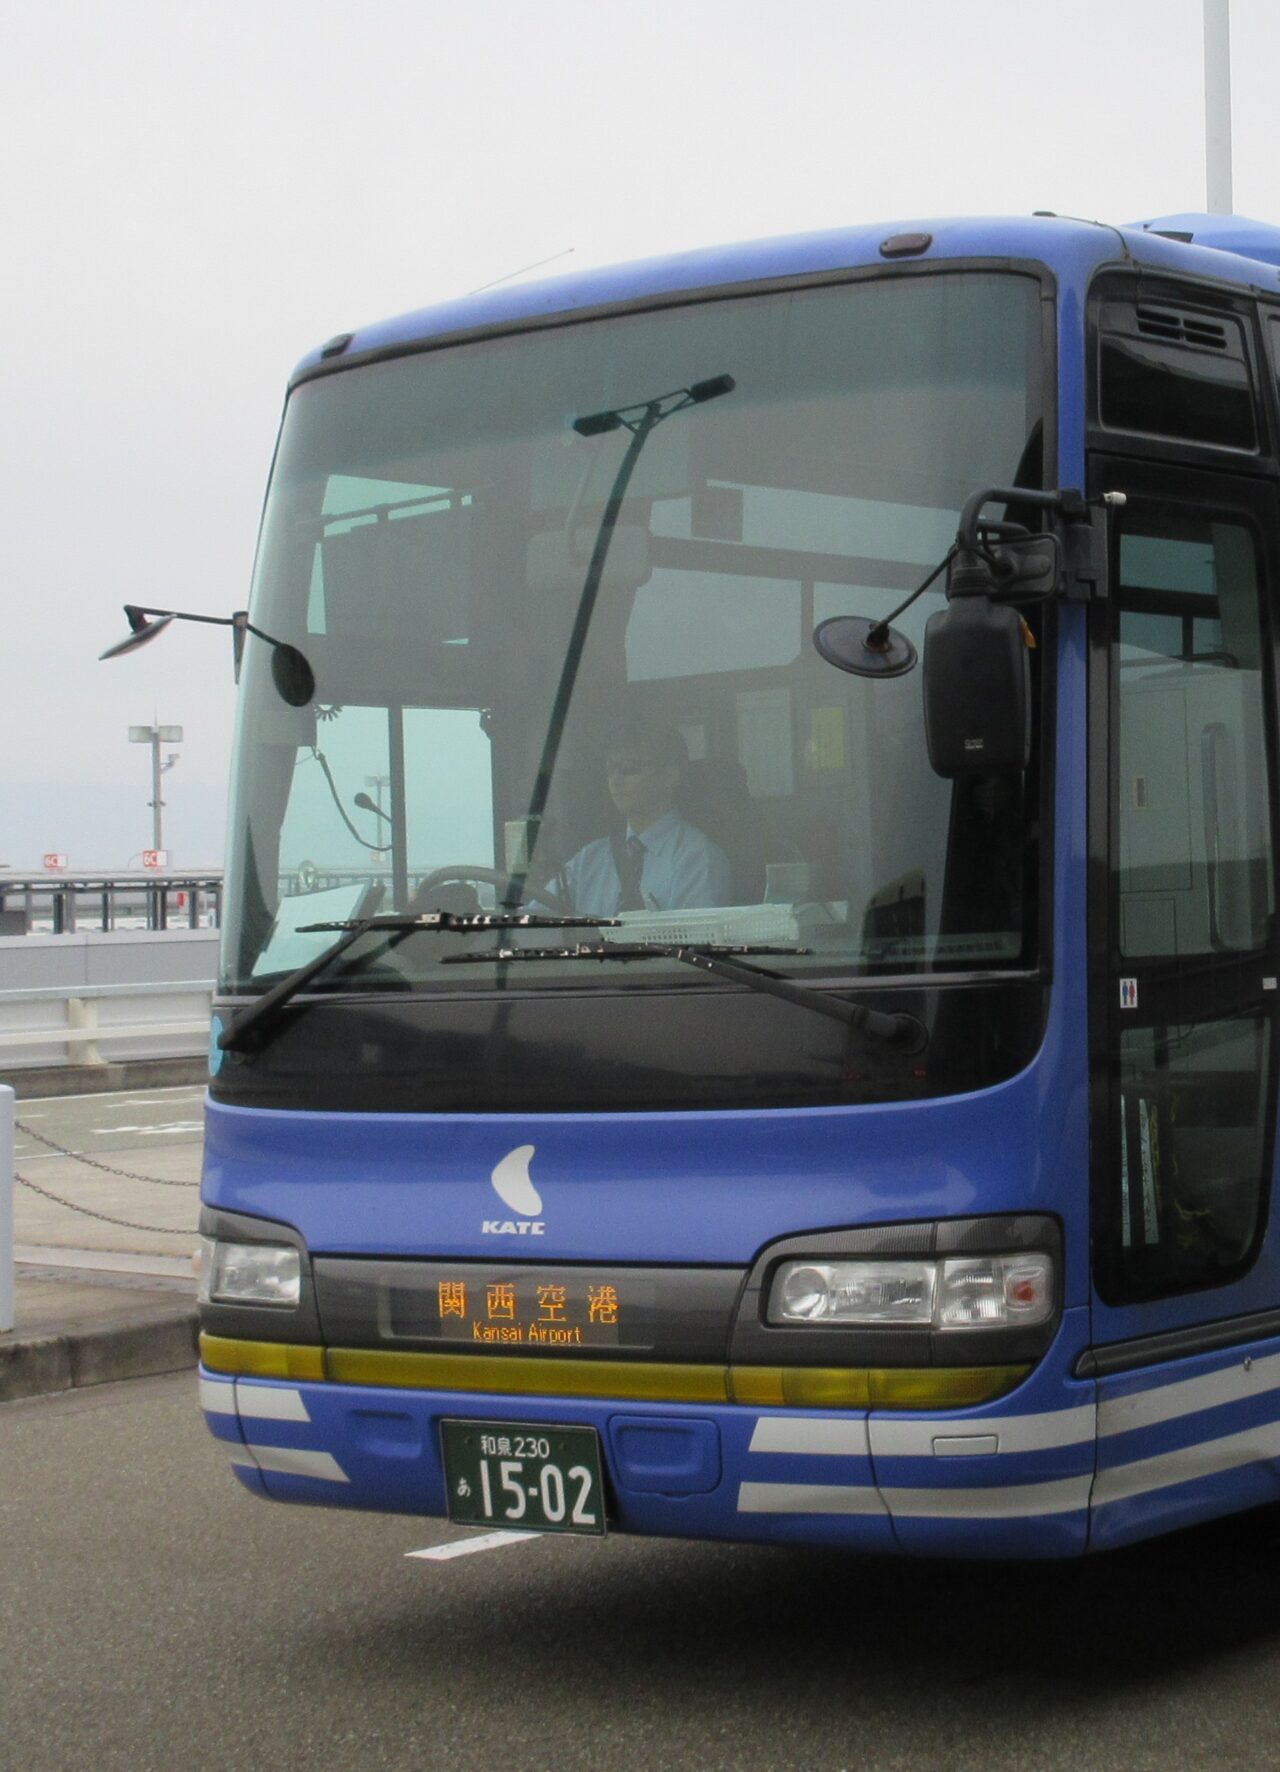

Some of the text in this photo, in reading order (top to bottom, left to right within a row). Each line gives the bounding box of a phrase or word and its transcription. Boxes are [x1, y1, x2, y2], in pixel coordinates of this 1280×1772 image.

[438, 1281, 619, 1325] 関西空港
[473, 1321, 582, 1344] Kansai Airport
[457, 1477, 471, 1497] あ
[480, 1459, 596, 1525] 15-02
